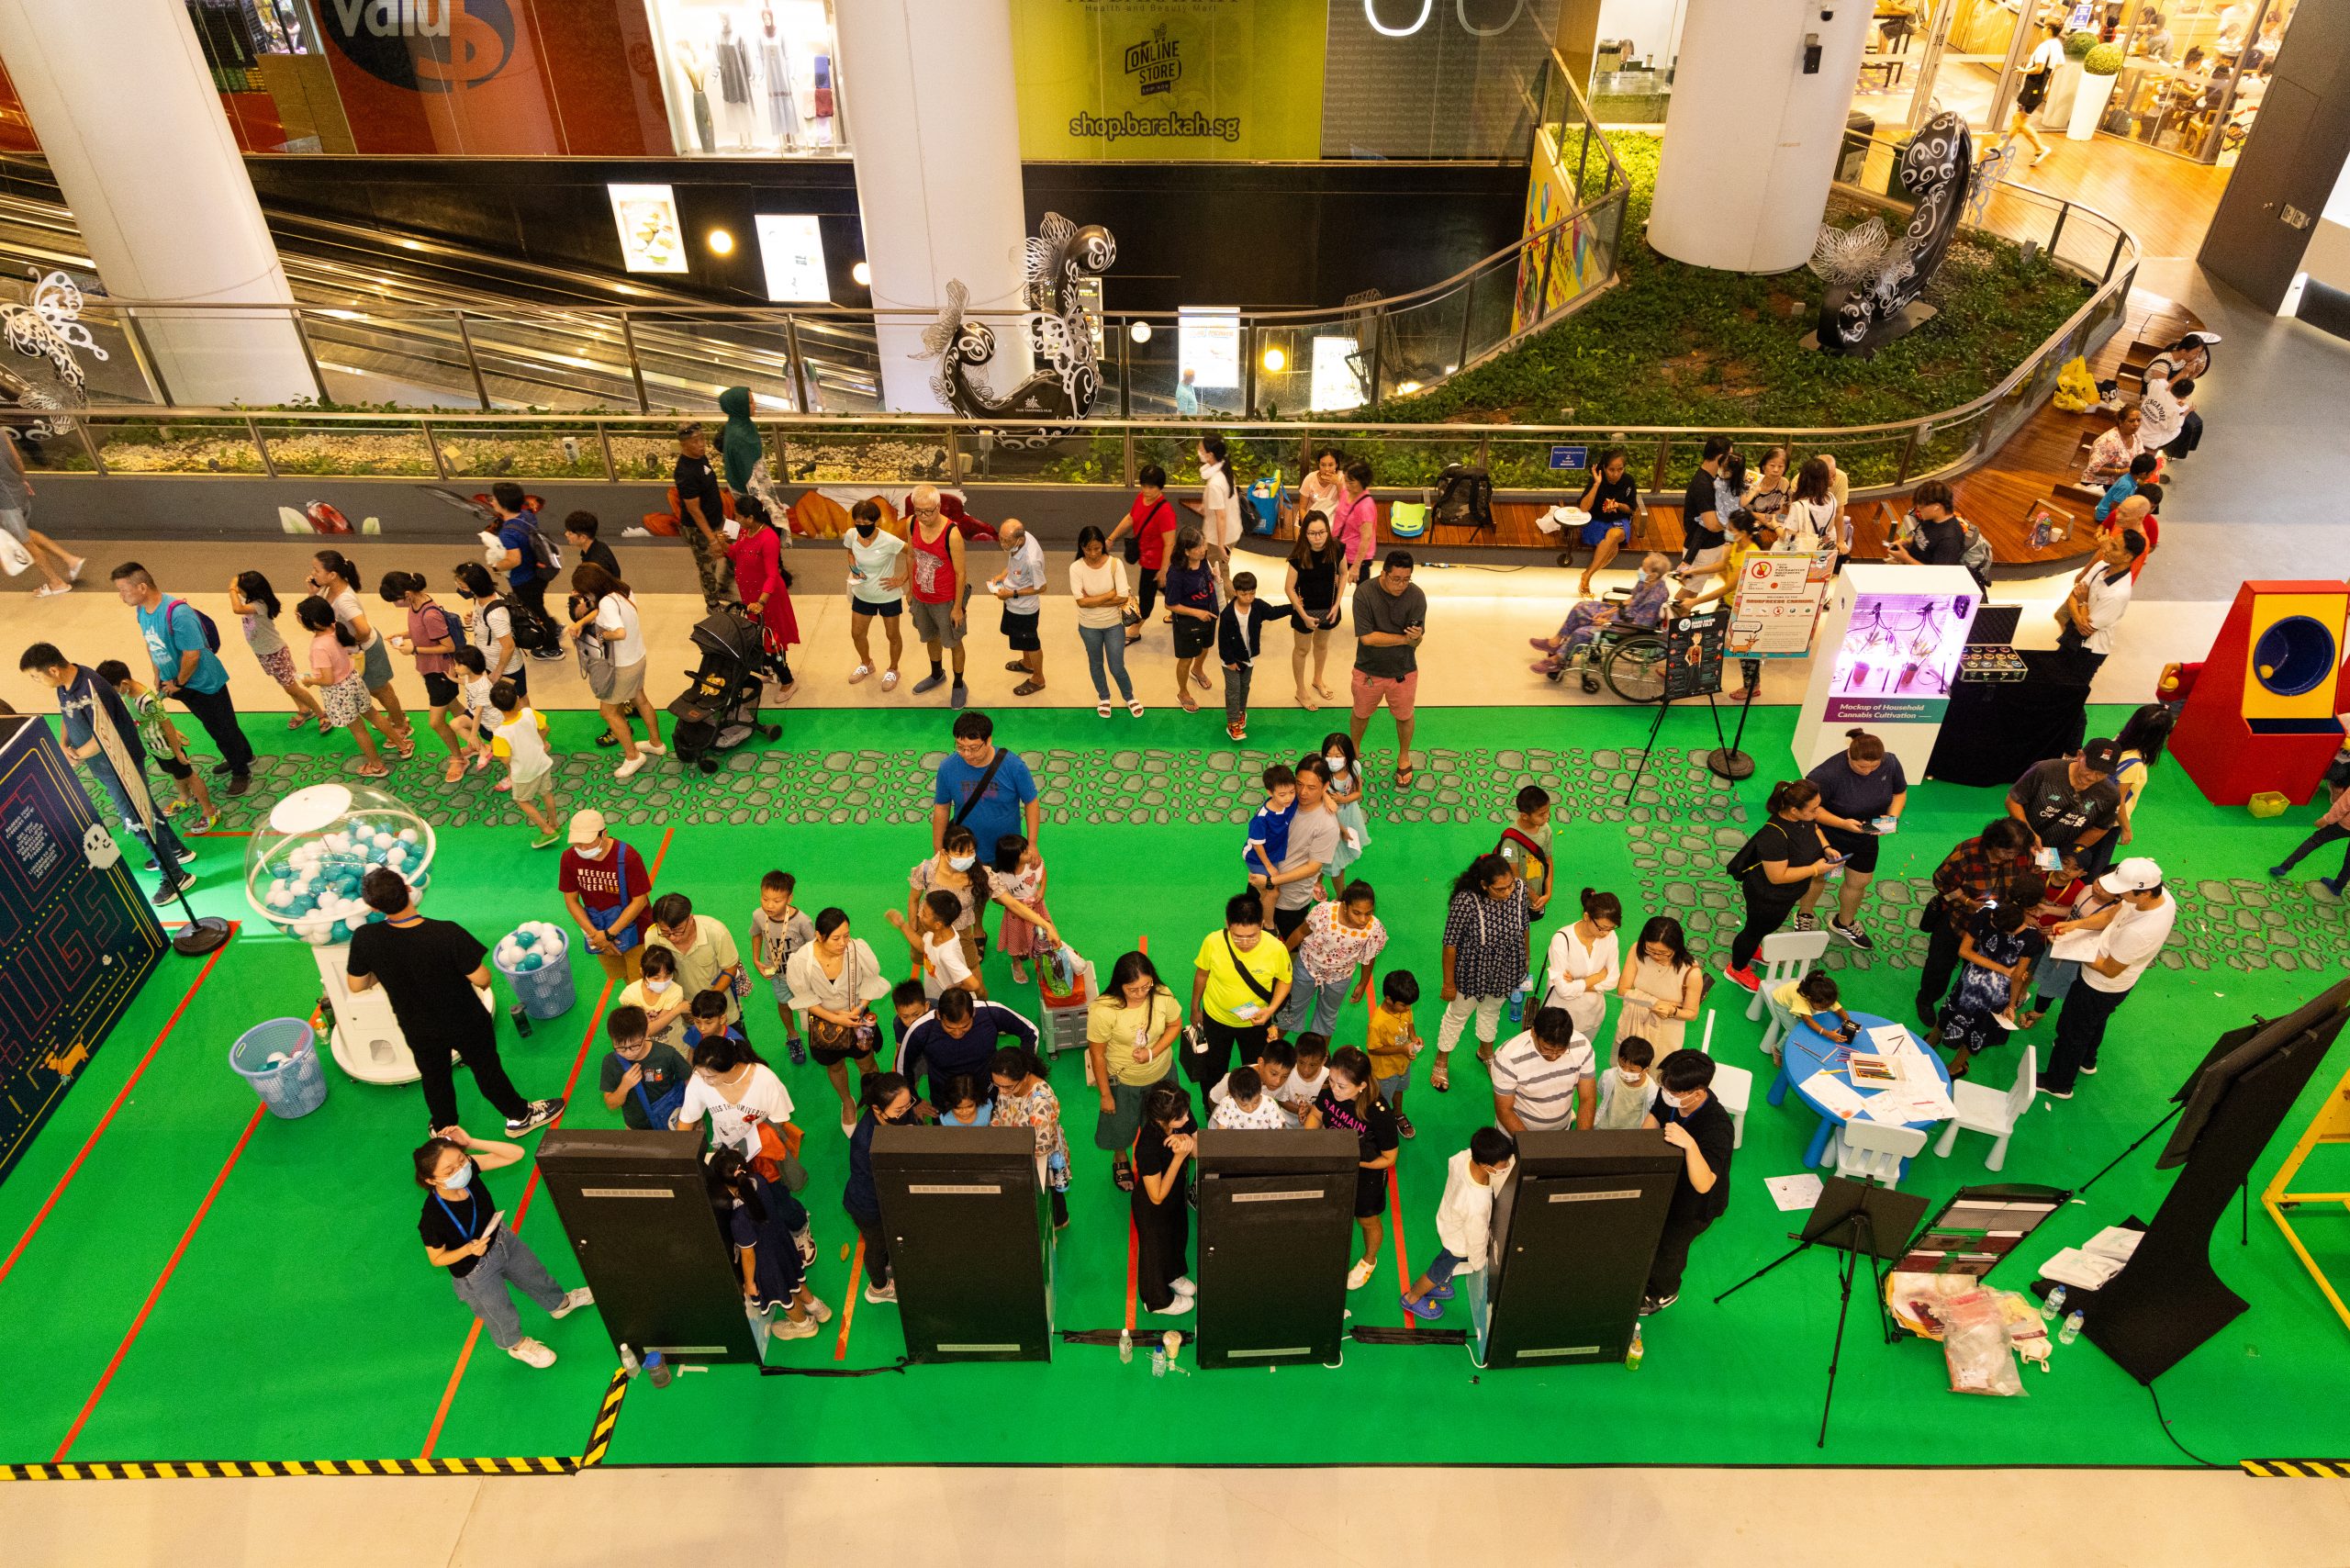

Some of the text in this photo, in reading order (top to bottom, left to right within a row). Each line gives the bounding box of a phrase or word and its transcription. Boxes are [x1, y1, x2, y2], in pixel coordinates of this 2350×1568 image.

[1131, 40, 1180, 68] ONLINE
[1139, 62, 1175, 84] STORE
[1069, 111, 1239, 141] shop.barakah.sg
[1324, 1098, 1367, 1133] BALMAIN
